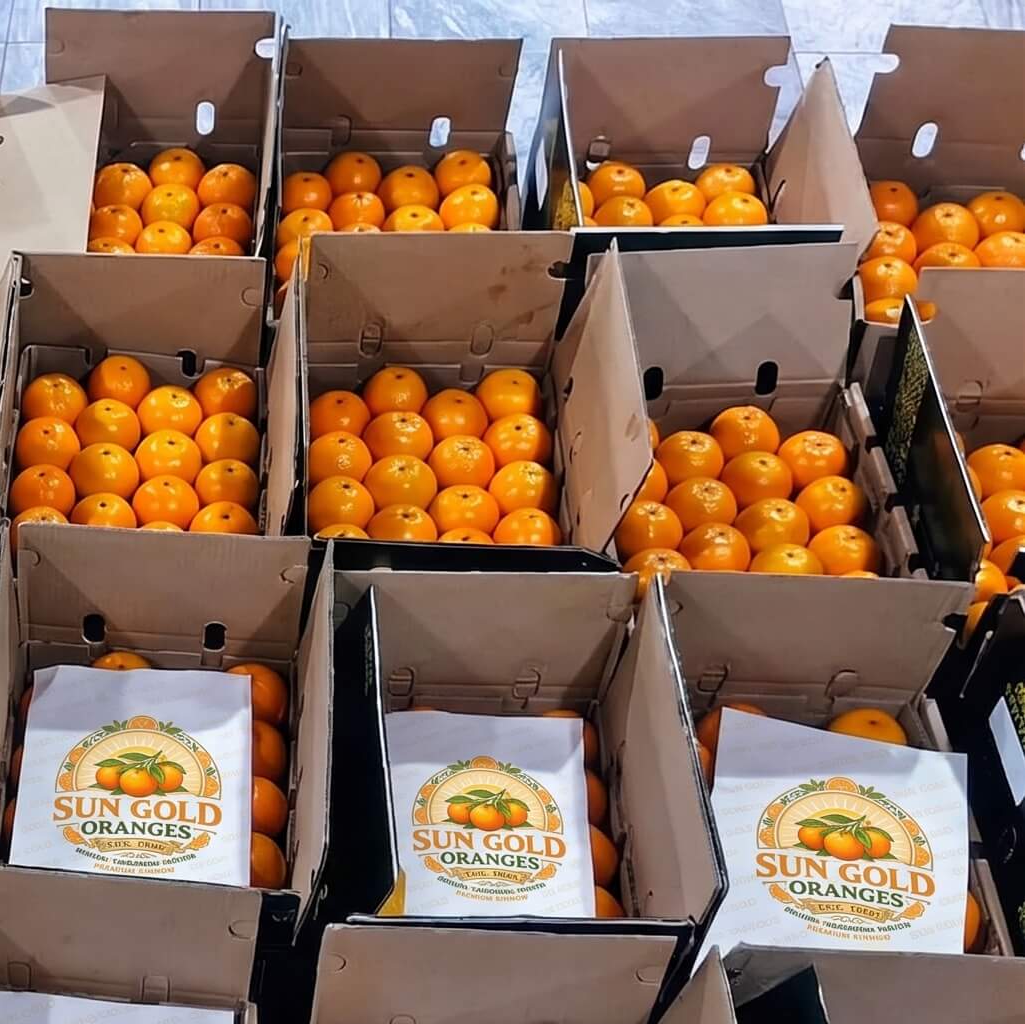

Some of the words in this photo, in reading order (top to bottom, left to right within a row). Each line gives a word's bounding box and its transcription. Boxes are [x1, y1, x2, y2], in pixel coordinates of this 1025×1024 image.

[53, 796, 122, 821] SUN
[130, 799, 223, 827] GOLD
[81, 820, 192, 840] ORANGES
[412, 829, 474, 851] SUN
[483, 834, 567, 858] GOLD
[440, 851, 540, 870] ORANGES
[756, 852, 828, 879] SUN
[839, 863, 936, 897] GOLD
[789, 880, 904, 908] ORANGES
